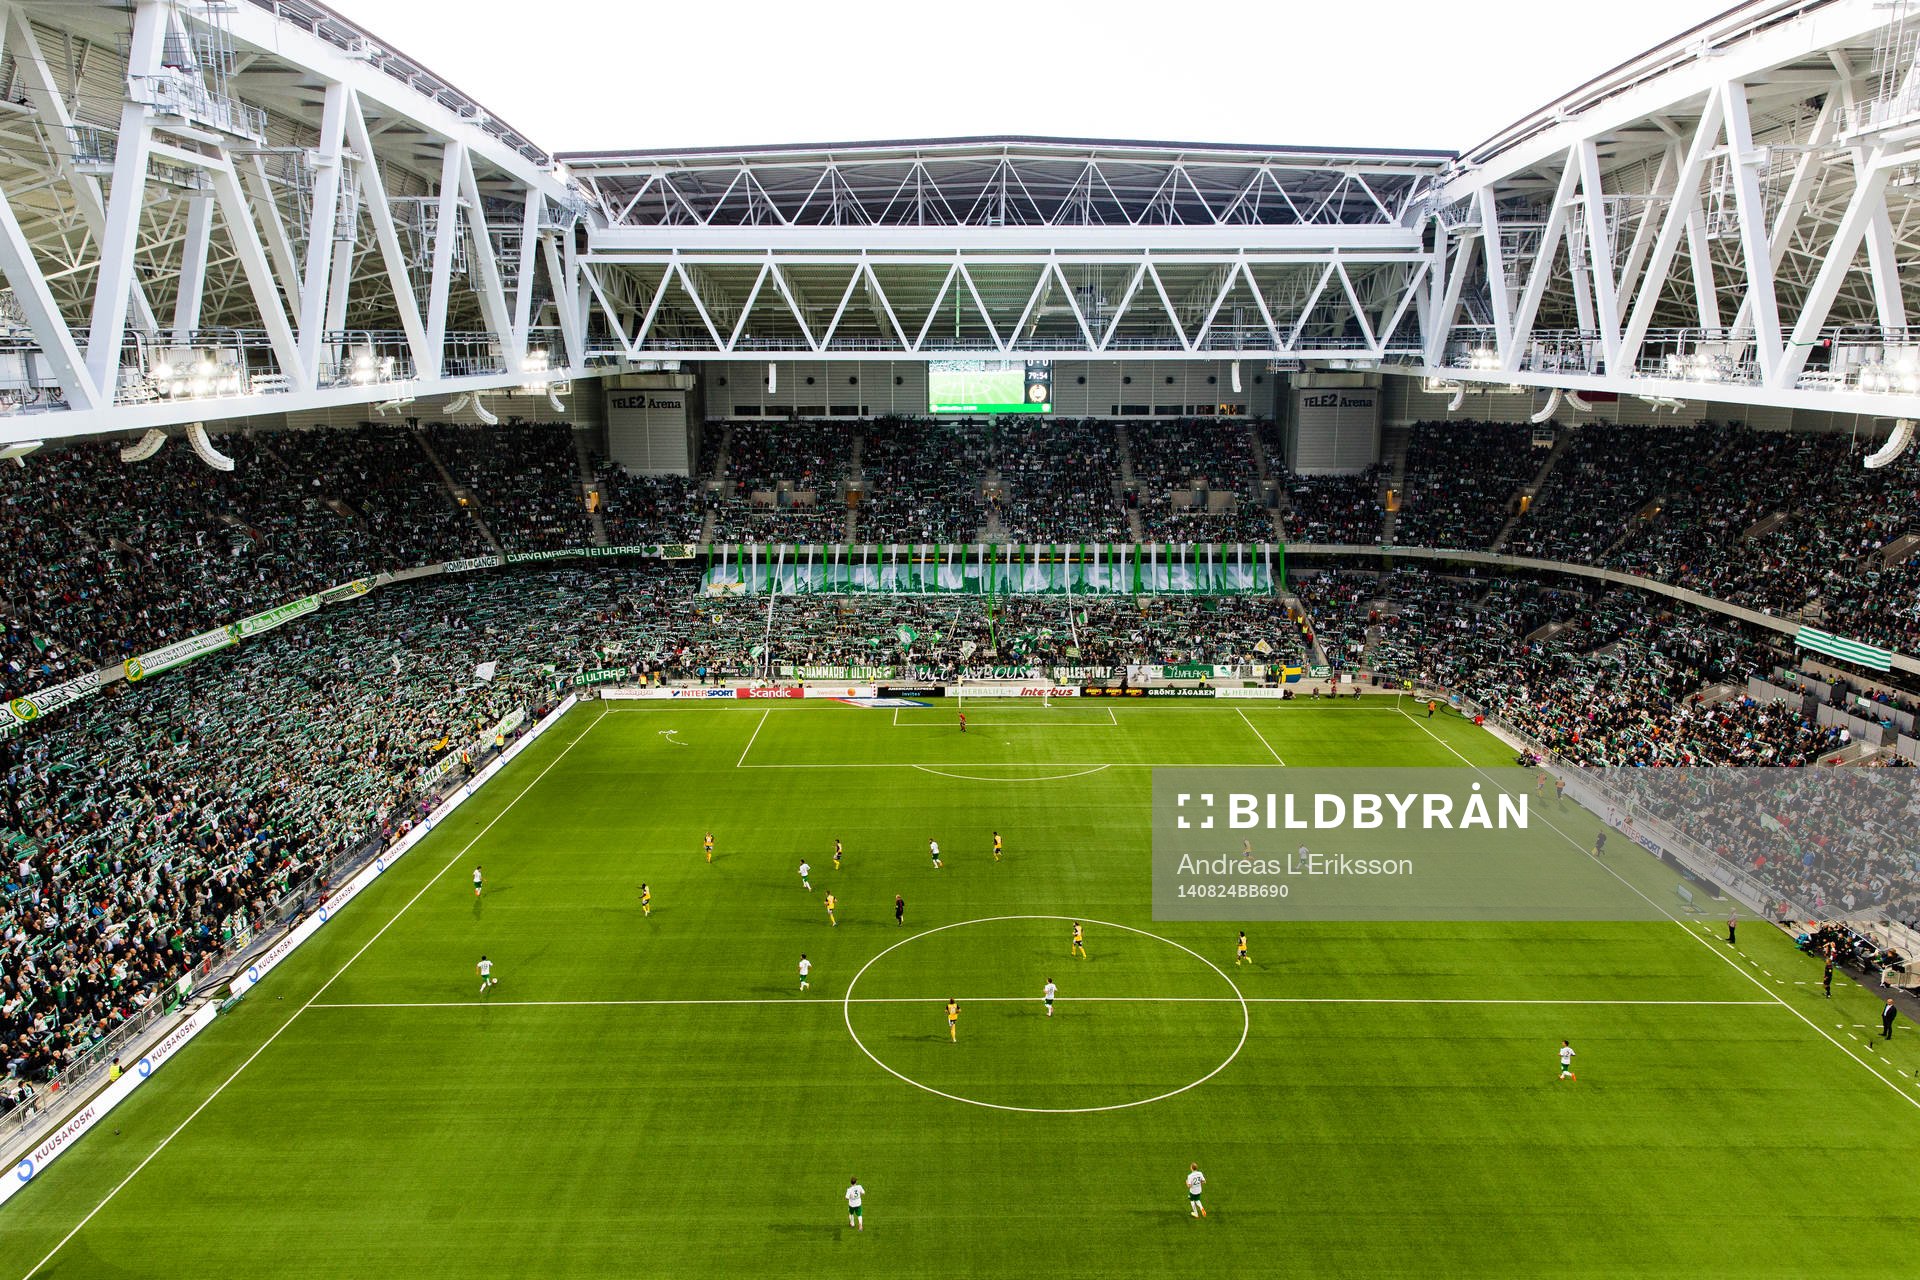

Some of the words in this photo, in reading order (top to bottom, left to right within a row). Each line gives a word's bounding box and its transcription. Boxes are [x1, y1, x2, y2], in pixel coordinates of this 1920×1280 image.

[1028, 372, 1047, 380] 79:54
[612, 396, 645, 408] TELE2
[648, 399, 681, 408] Arena
[1304, 394, 1337, 407] TELE2
[1340, 397, 1373, 407] Arena
[507, 551, 541, 563] CURVA
[603, 545, 640, 555] ULTRAS
[586, 668, 626, 682] ULTRAS
[806, 666, 849, 679] HAMMARBY
[851, 666, 882, 679] ULTRAS
[749, 688, 791, 698] Scandic
[1021, 687, 1073, 697] Interbus
[1148, 688, 1175, 696] GRÖNE
[1177, 688, 1215, 696] JÄGAREN
[258, 937, 294, 970] KUUSAKOSKI
[151, 1018, 197, 1062] KUUSAKOSKI
[35, 1107, 95, 1162] KUUSAKOSKI
[1193, 1176, 1201, 1185] 23
